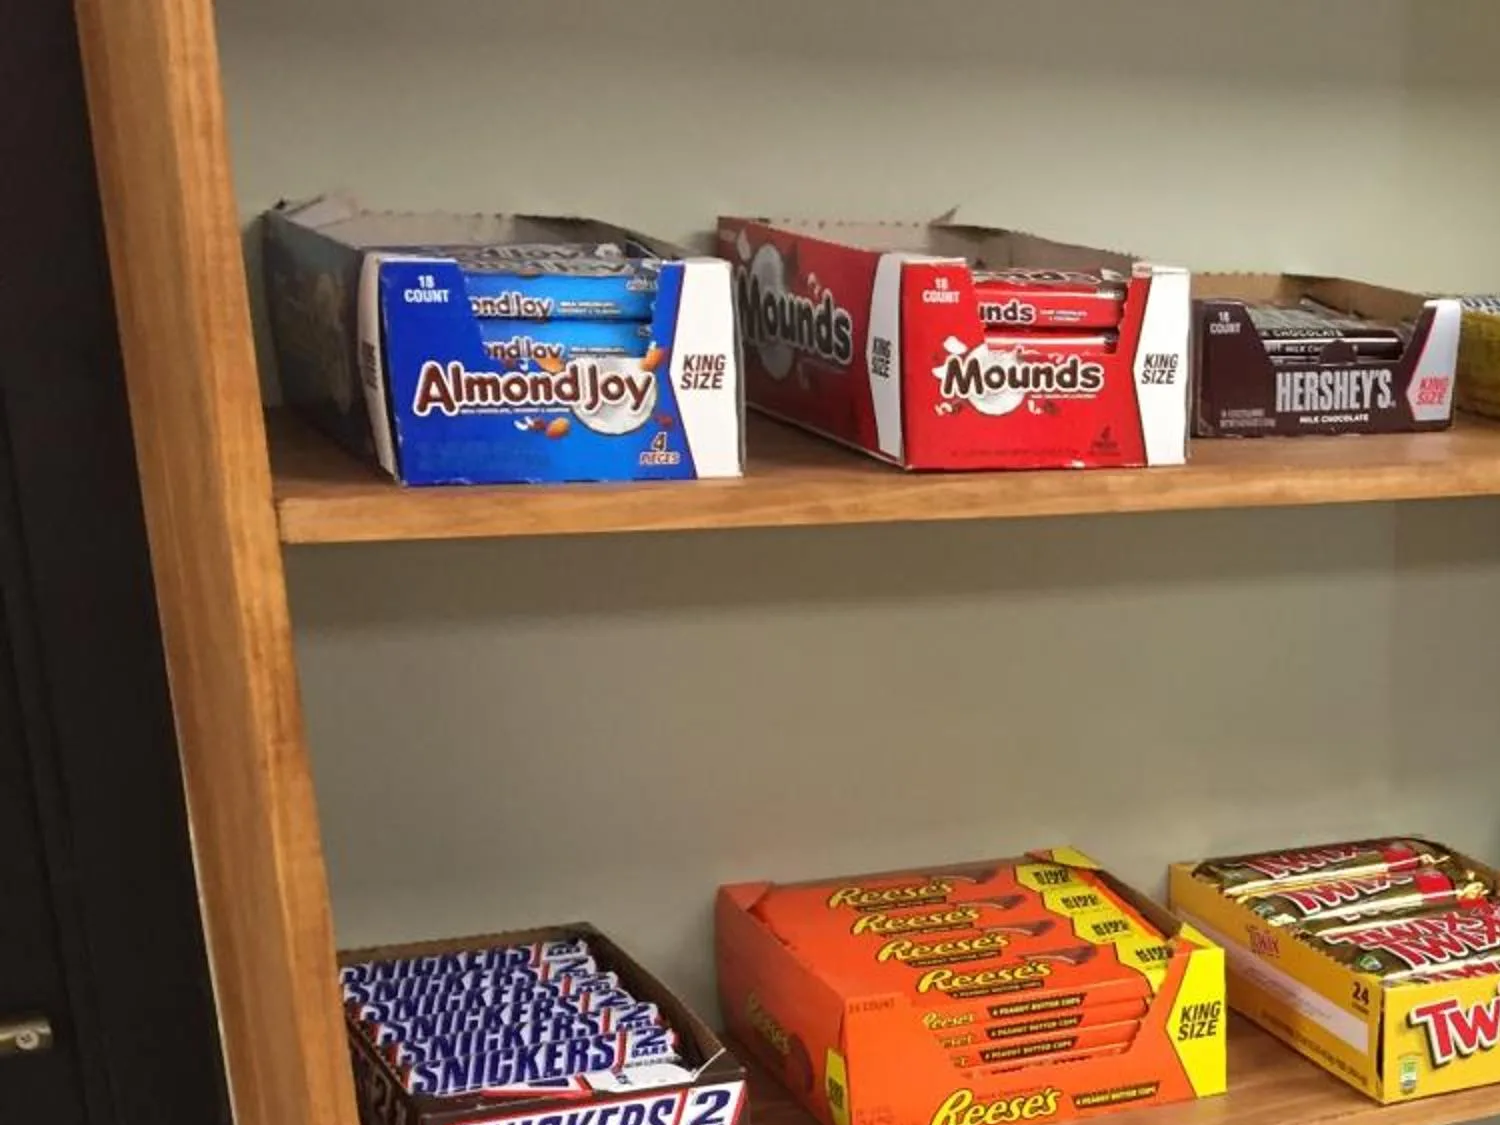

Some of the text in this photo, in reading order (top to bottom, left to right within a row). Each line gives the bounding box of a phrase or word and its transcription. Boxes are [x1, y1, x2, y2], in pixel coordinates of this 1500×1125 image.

[404, 288, 449, 303] COUNT
[735, 268, 853, 365] Mounds
[683, 355, 726, 373] KING
[1143, 354, 1178, 370] KING
[680, 372, 723, 390] SIZE
[941, 355, 1104, 398] Mounds
[1141, 368, 1175, 385] SIZE
[414, 362, 655, 416] Almond Joy
[1276, 369, 1393, 412] HERSHEY'S
[1300, 413, 1369, 424] MILK CHOCOLATE
[852, 907, 980, 935] Reese's
[877, 932, 1010, 962] Reese's
[917, 961, 1052, 993] Reese's
[1353, 982, 1370, 1002] 24
[1180, 1001, 1221, 1024] KING
[1177, 1020, 1217, 1041] SIZE
